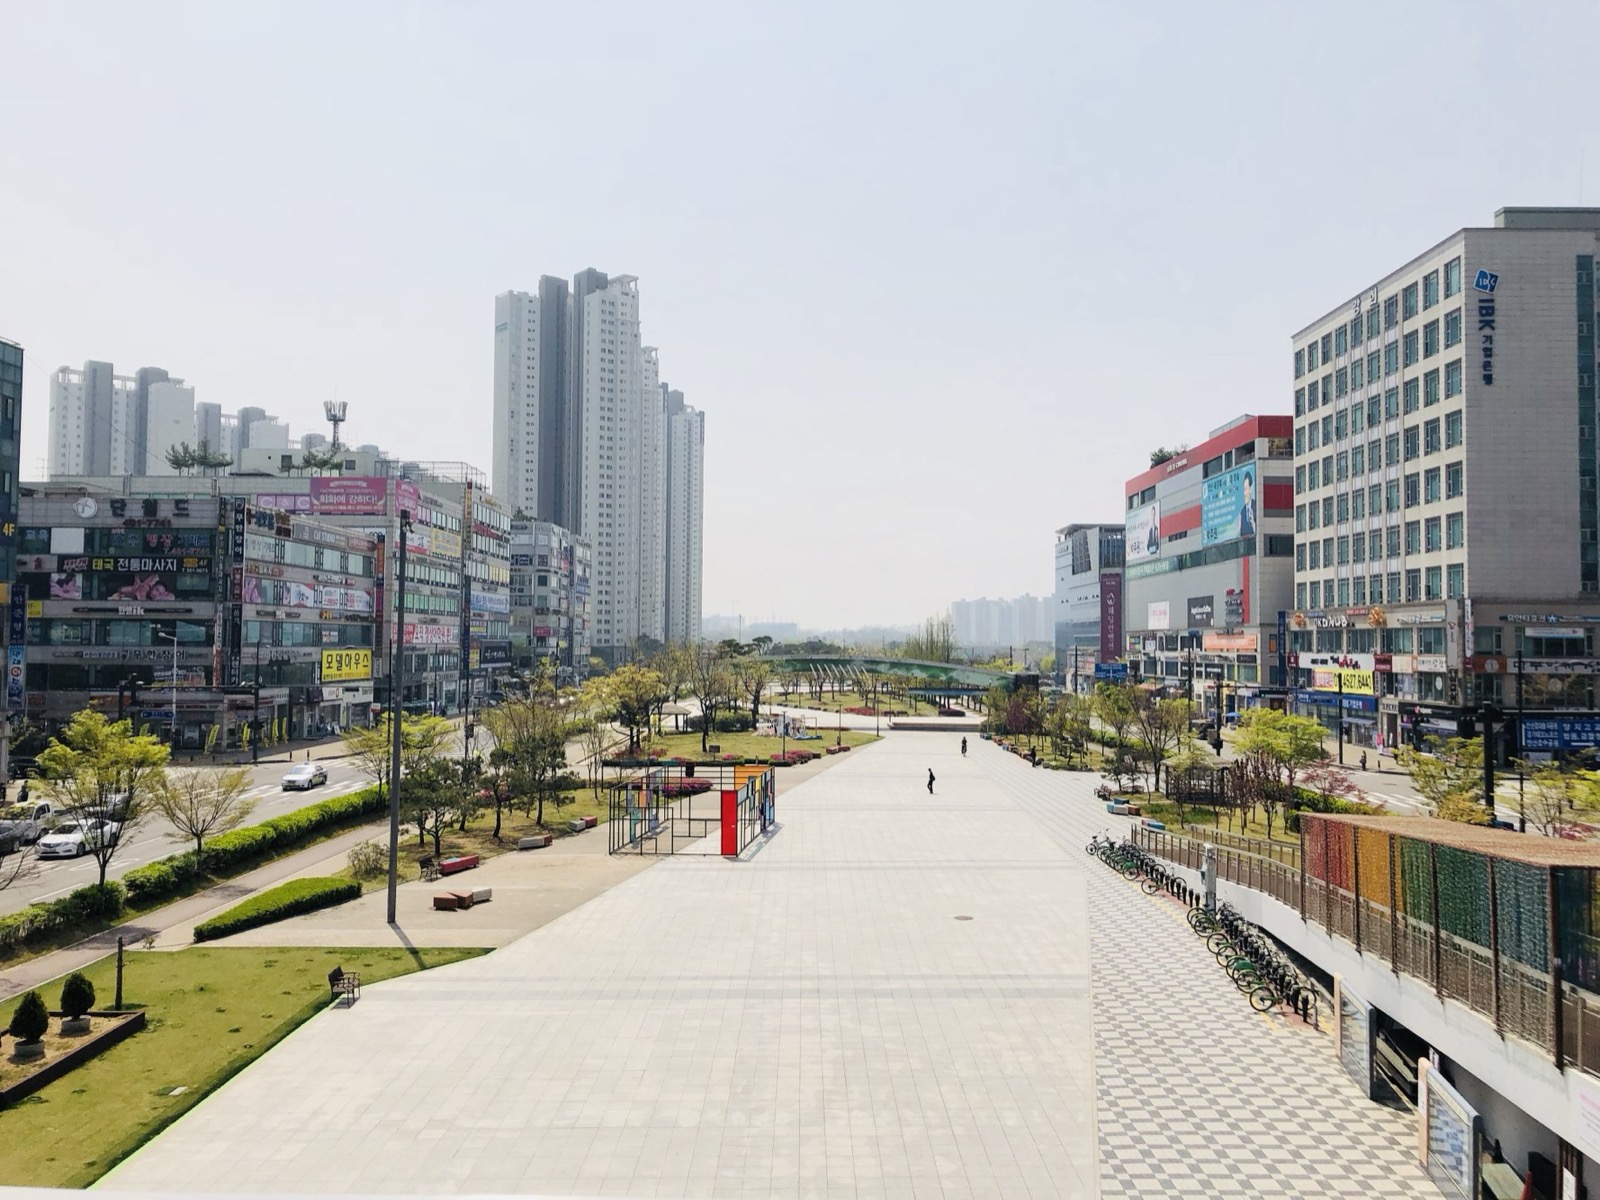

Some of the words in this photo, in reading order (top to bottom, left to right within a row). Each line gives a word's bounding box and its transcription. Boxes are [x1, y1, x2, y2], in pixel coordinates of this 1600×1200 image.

[2, 522, 16, 537] 4F
[92, 558, 114, 571] 태국
[117, 558, 177, 571] 전통마사지
